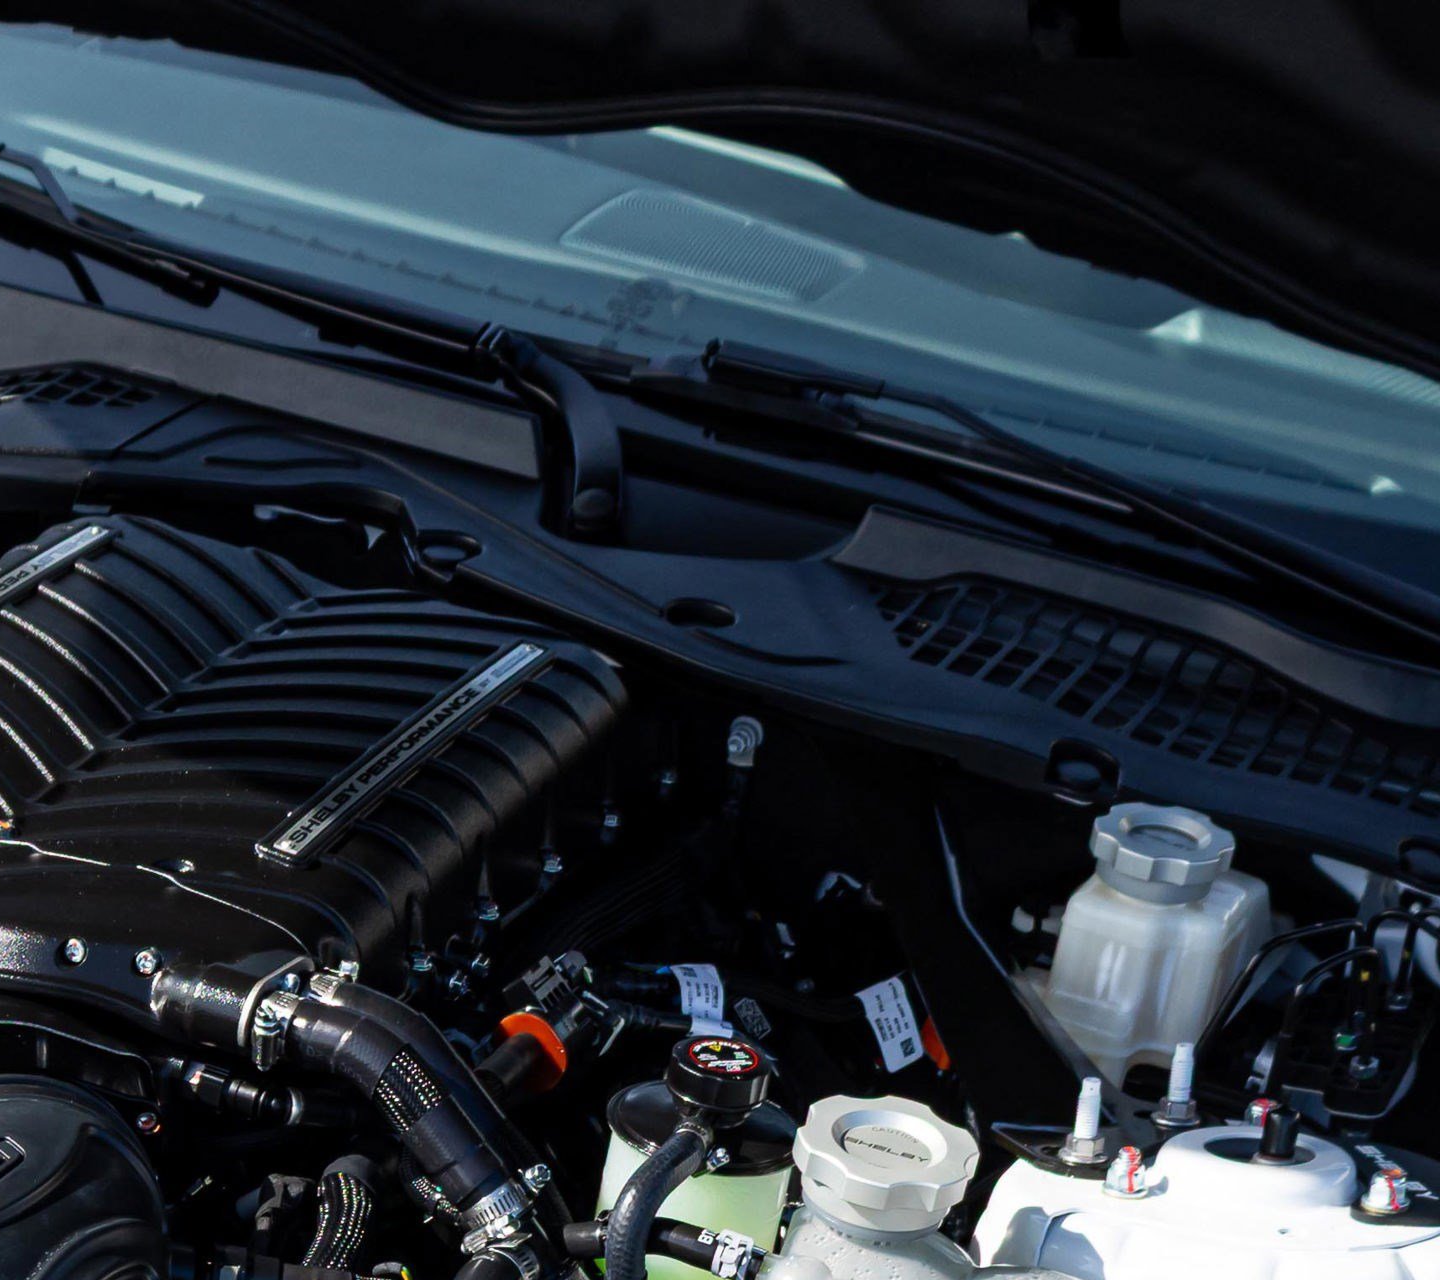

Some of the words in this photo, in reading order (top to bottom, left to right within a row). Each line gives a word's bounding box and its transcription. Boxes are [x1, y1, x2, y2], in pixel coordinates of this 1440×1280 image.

[288, 783, 360, 847] SHELBY
[360, 688, 477, 788] PERFORMANCE
[844, 1136, 929, 1162] SHELBY
[1354, 1145, 1440, 1200] SHEBY
